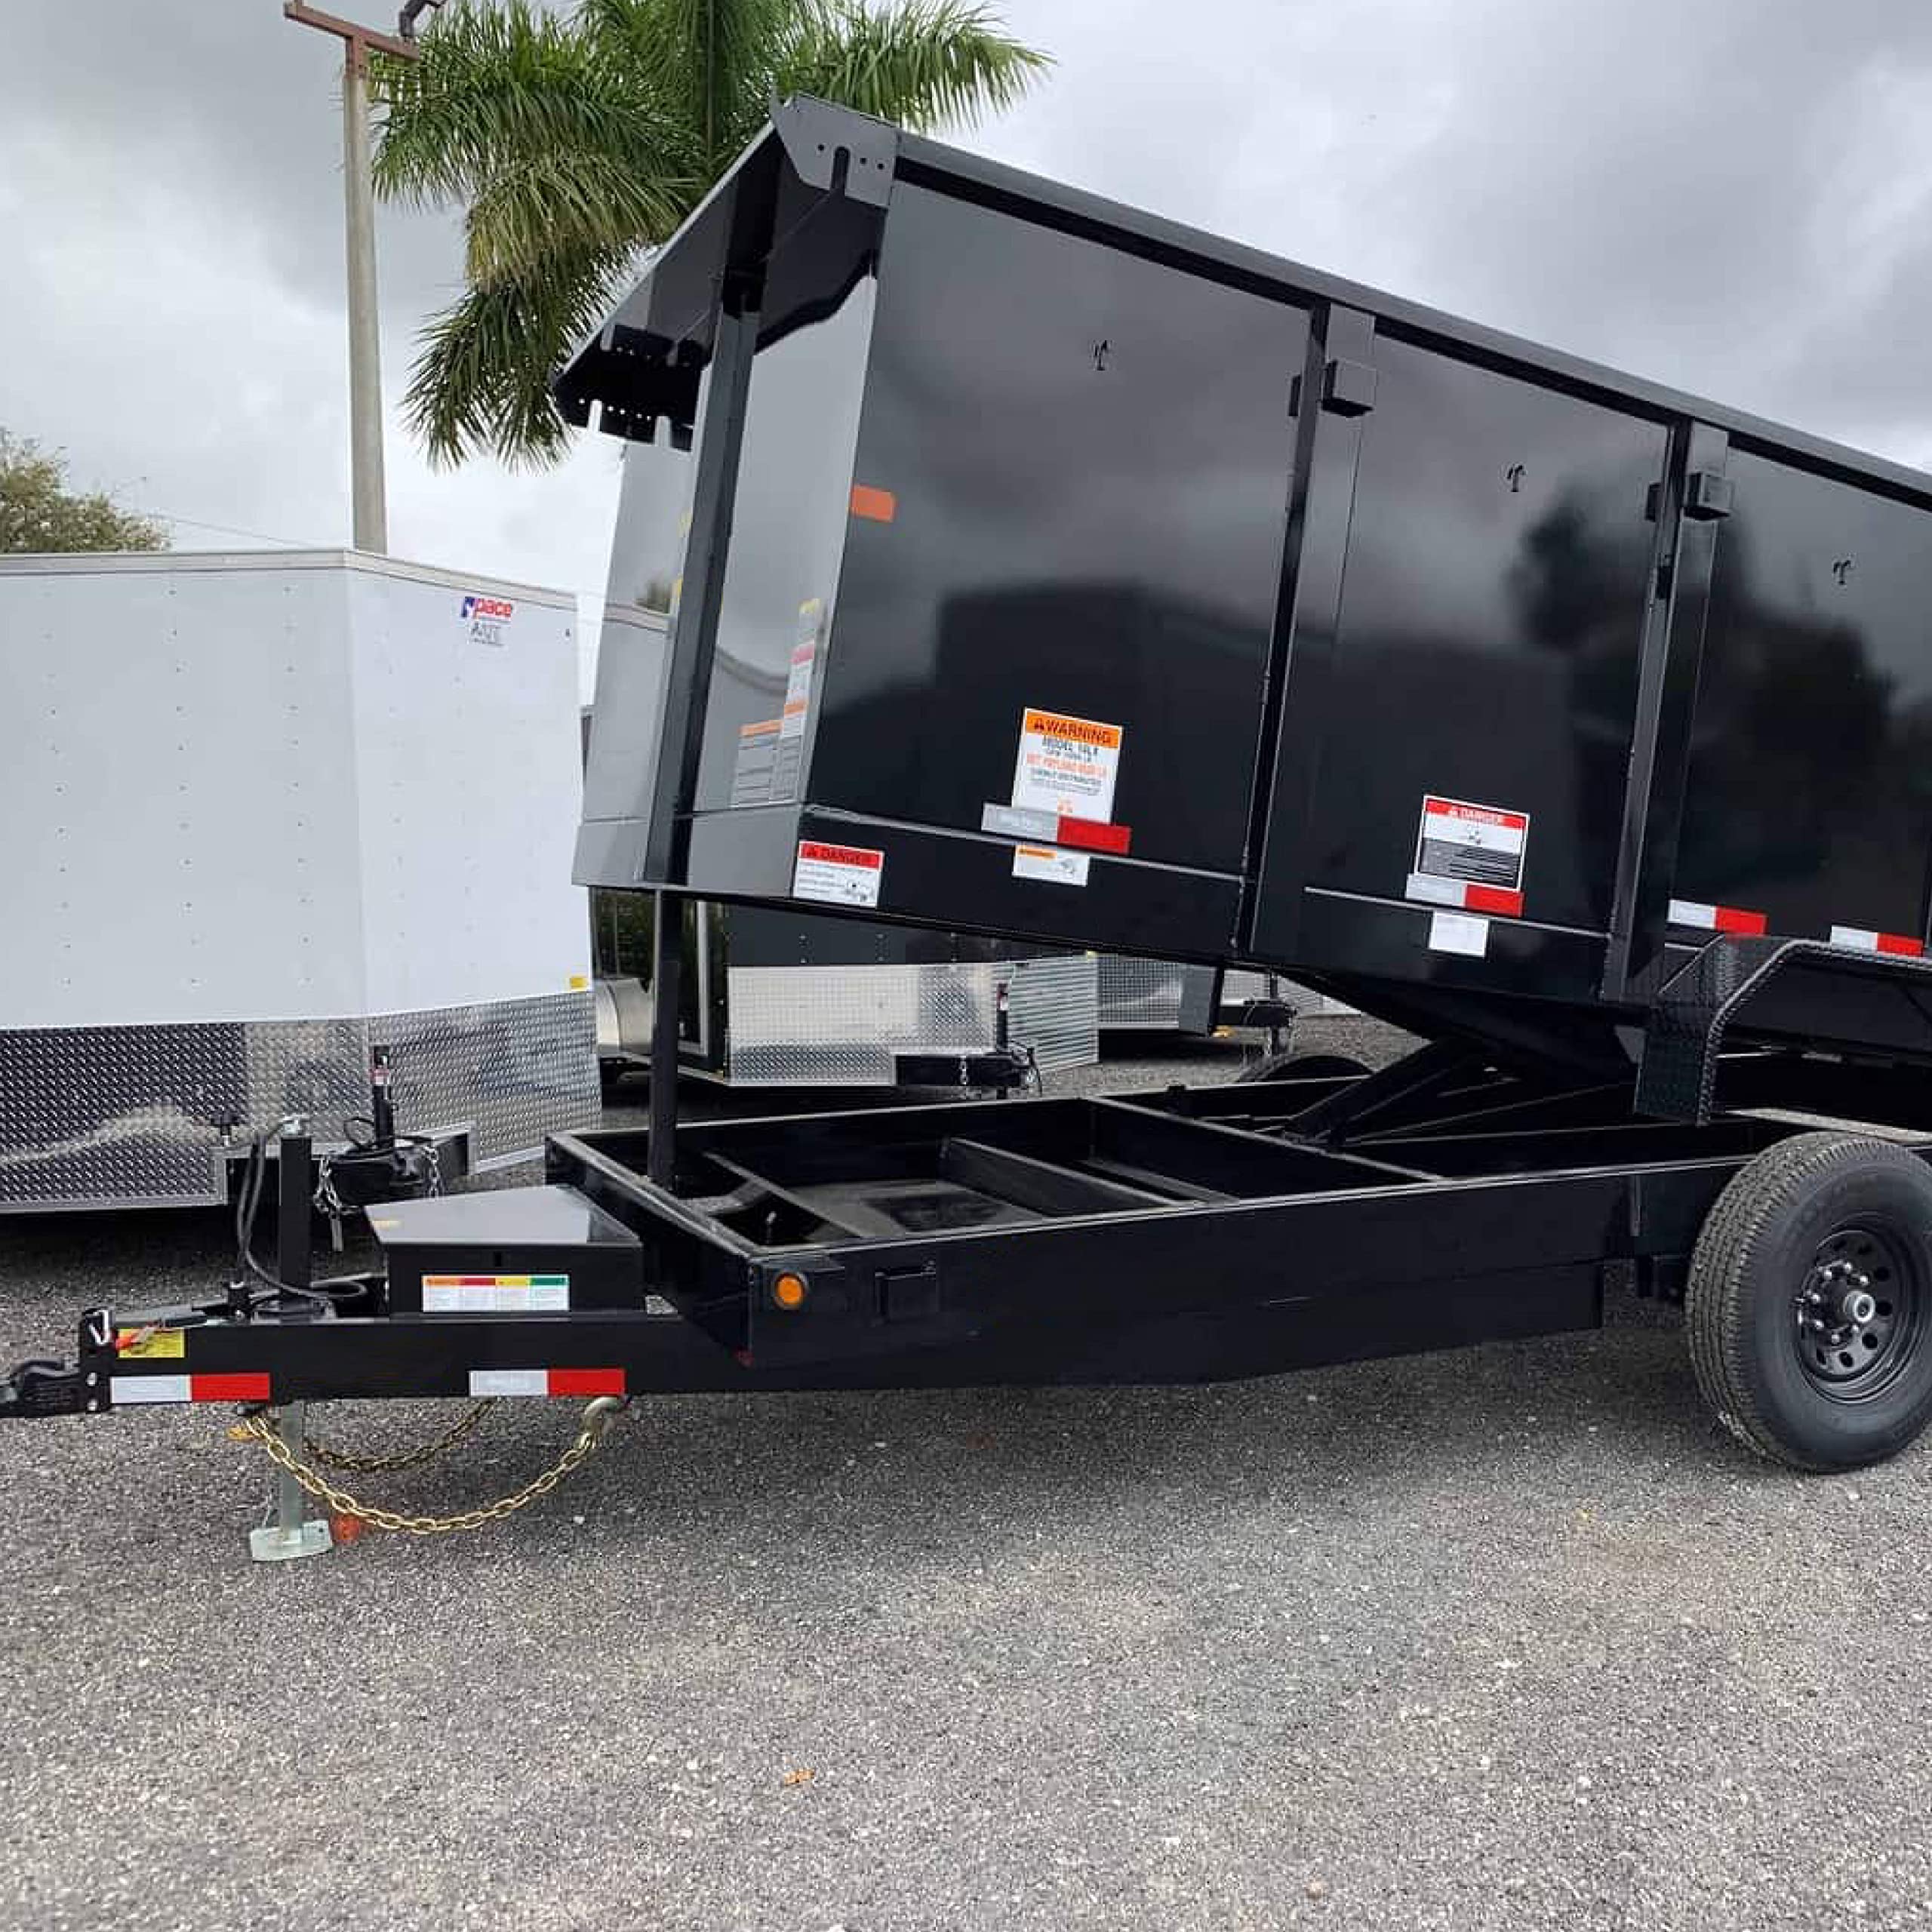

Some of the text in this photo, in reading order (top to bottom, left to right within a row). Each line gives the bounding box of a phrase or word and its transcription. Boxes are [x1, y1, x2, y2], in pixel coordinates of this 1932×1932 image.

[1046, 718, 1112, 744] WARNING
[1460, 808, 1503, 825] DANGER
[820, 848, 870, 866] DANGER
